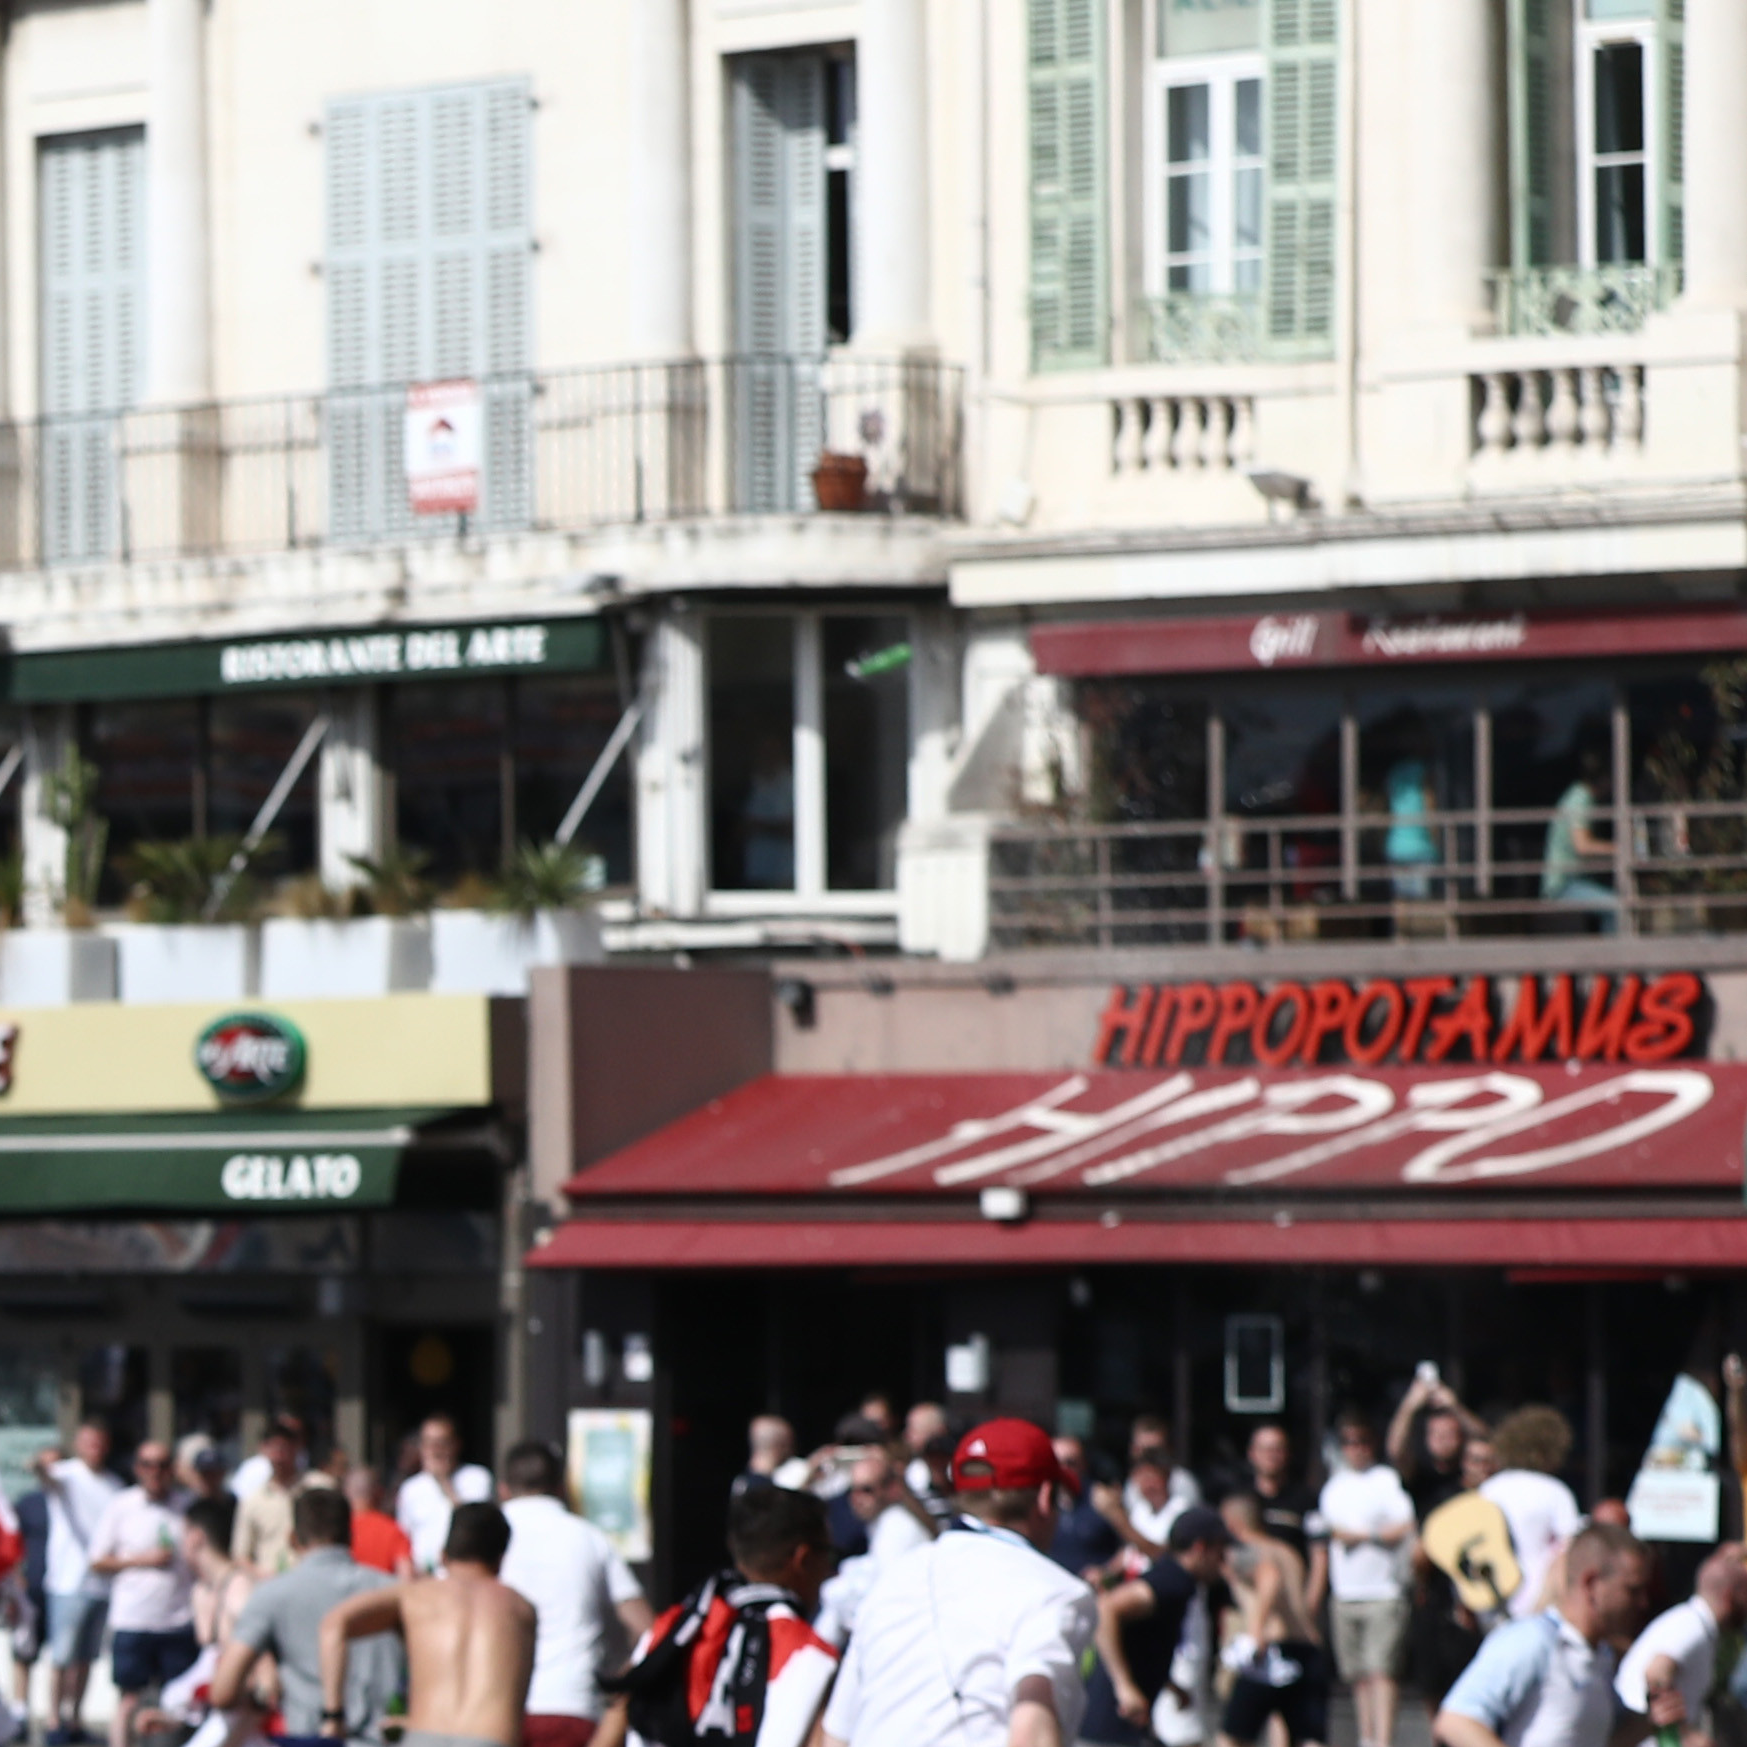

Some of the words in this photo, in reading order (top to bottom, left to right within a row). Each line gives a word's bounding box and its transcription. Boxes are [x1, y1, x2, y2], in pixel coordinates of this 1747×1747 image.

[220, 633, 403, 684] RISTORANTE
[406, 630, 461, 671] DEL
[466, 624, 548, 664] ARTE
[1094, 971, 1704, 1068] HIPPOPOTAMUS
[829, 1071, 1712, 1187] HIPPO
[220, 1153, 362, 1200] GELATO
